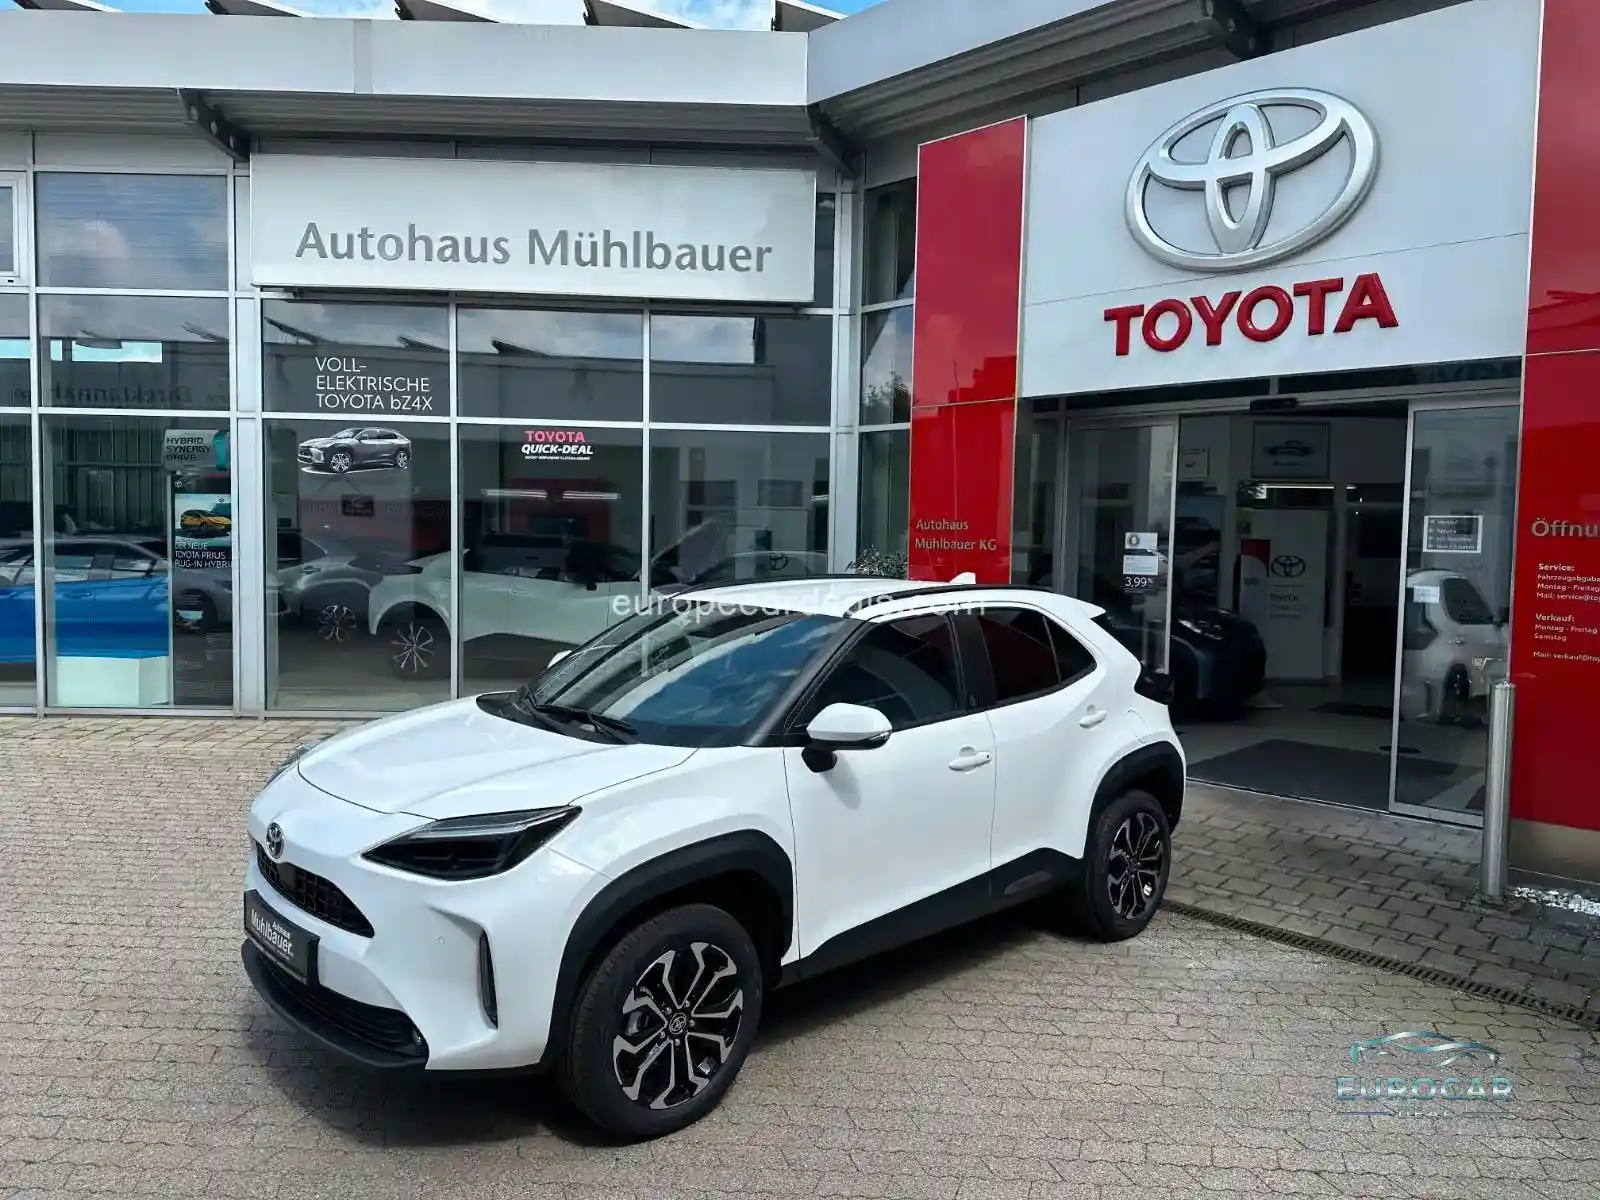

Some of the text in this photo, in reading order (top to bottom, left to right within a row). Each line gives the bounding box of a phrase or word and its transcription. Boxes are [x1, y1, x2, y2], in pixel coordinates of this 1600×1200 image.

[296, 222, 773, 272] Autohaus Mühlbauer
[1103, 272, 1399, 357] TOYOTA
[315, 356, 367, 373] VOLL-
[316, 375, 431, 392] ELEKTRISCHE
[316, 393, 433, 411] TOYOTA bZ4X
[166, 437, 204, 445] HYBRID
[525, 430, 585, 443] TOYOTA
[521, 444, 594, 454] QUICK-DEAL
[916, 518, 969, 530] Autohaus
[1531, 516, 1599, 537] Öffnu
[915, 537, 997, 551] Mühlbauer KG
[175, 550, 226, 560] TOYOTA PRIUS
[175, 560, 203, 568] PLUG-IN
[1538, 562, 1575, 572] Service:
[1537, 583, 1566, 591] Montag
[1535, 613, 1575, 622] Verkauf:
[1571, 626, 1598, 634] Freitag
[1534, 632, 1567, 642] Samstag
